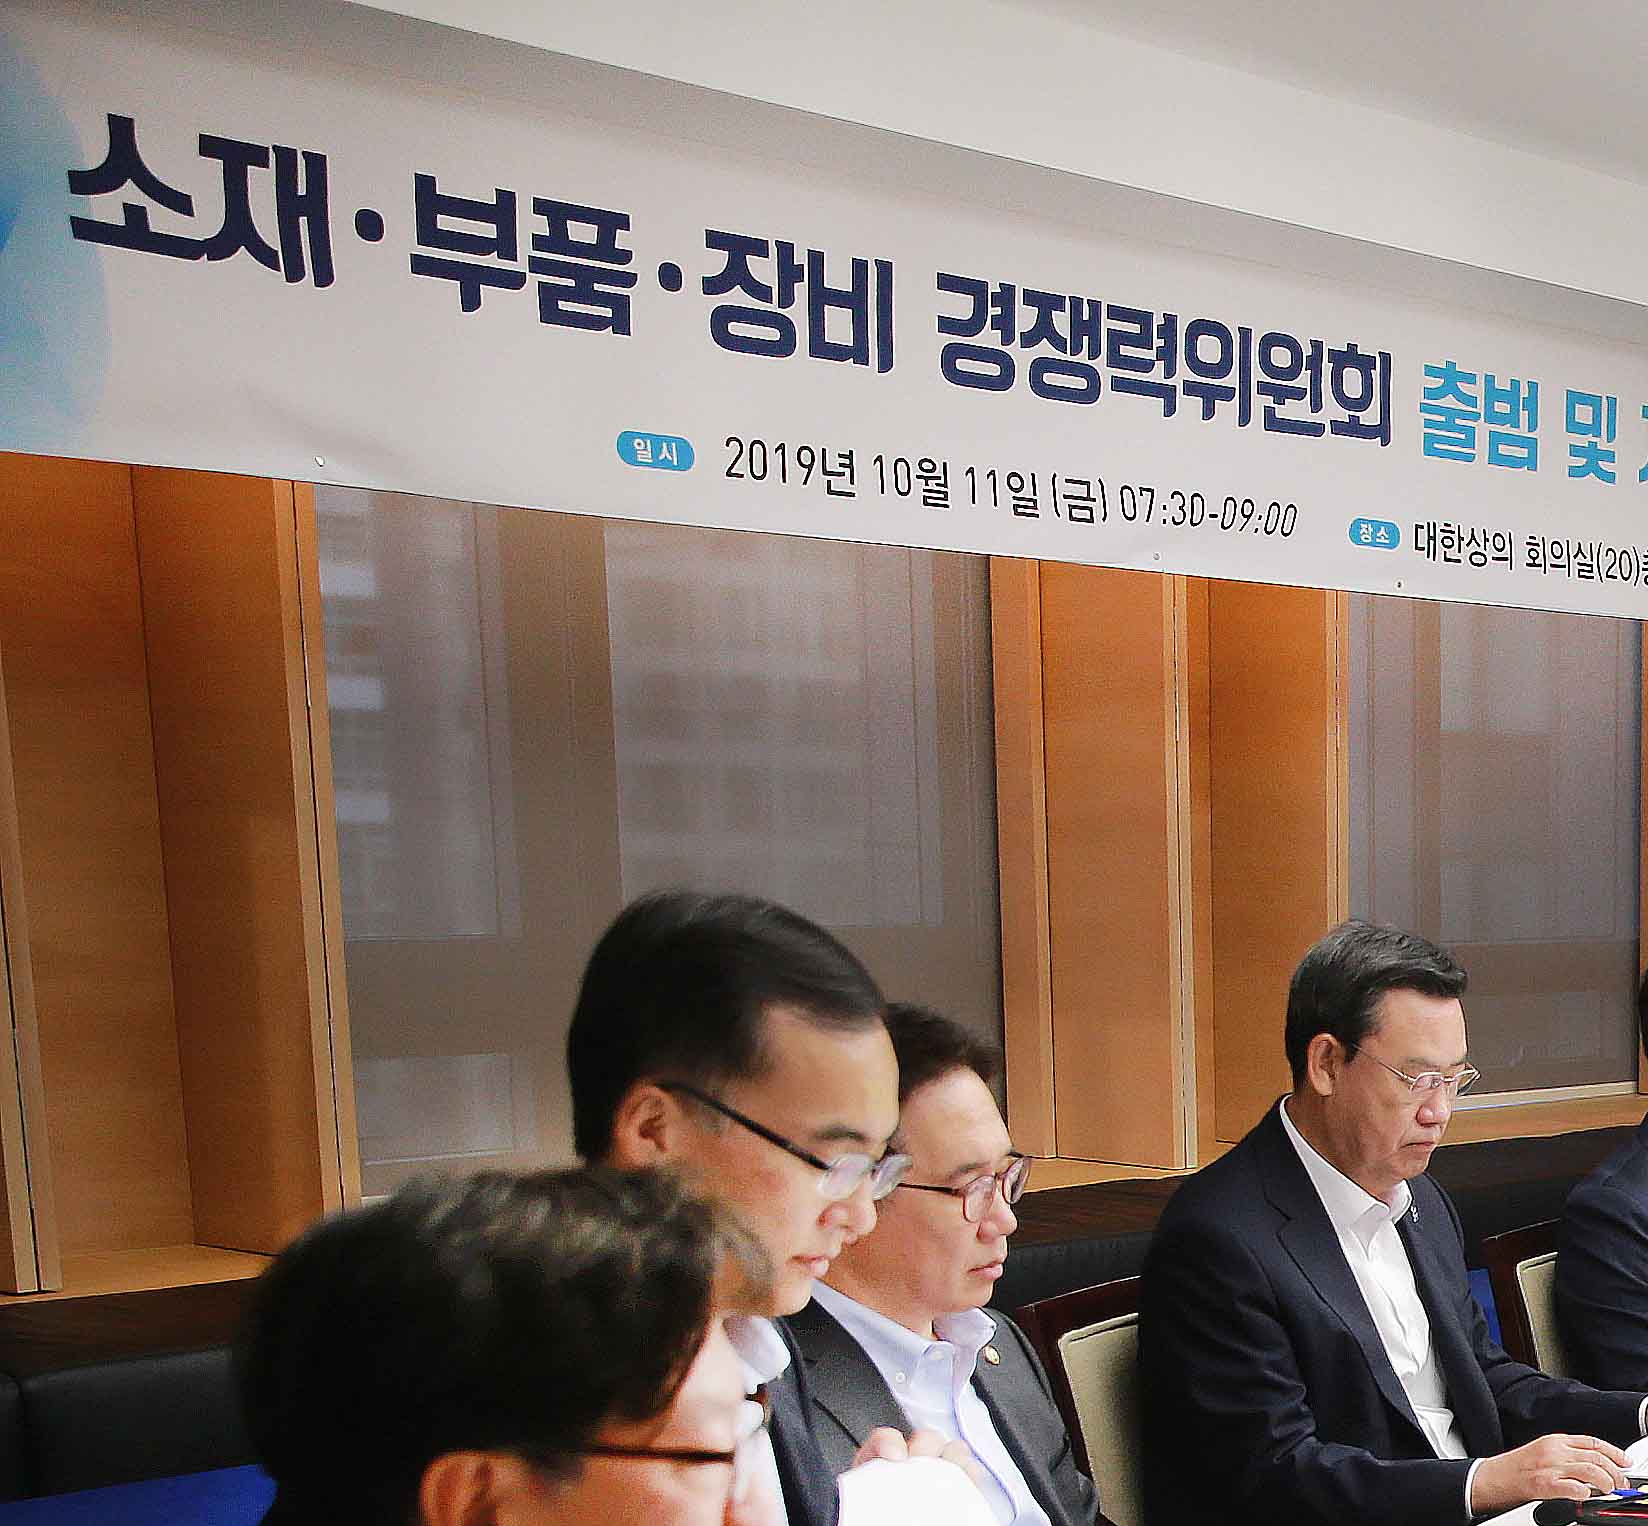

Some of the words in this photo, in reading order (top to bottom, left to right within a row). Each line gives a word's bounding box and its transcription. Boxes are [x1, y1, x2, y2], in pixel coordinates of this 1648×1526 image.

[936, 271, 1392, 448] 경쟁력위원회
[1419, 360, 1540, 474] 출범
[1565, 389, 1618, 483] 및
[633, 437, 678, 467] 일시
[724, 435, 856, 498] 2019년
[872, 453, 950, 509] 10월
[964, 465, 1040, 519] 11일
[1050, 472, 1108, 524] (금)
[1119, 484, 1299, 538] 07:30-09:00
[1359, 522, 1392, 545] 장소
[1413, 520, 1514, 571] 대한상의
